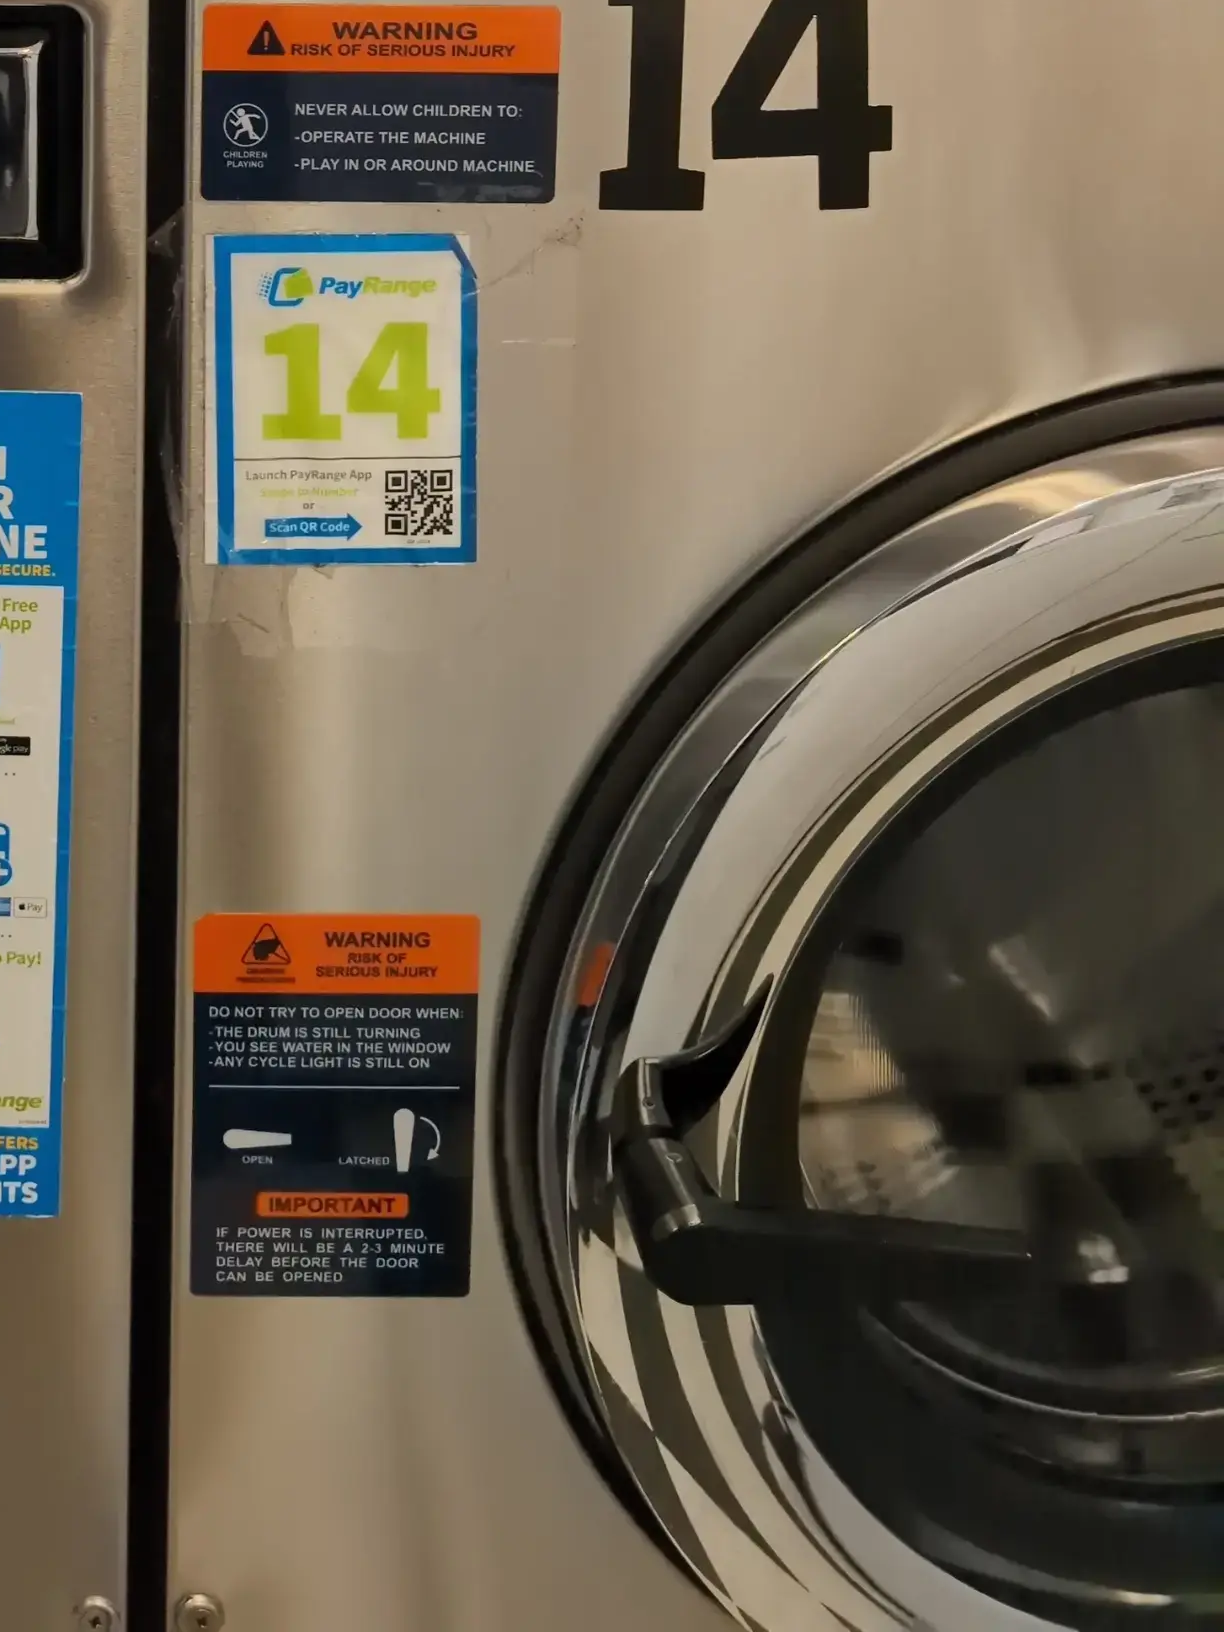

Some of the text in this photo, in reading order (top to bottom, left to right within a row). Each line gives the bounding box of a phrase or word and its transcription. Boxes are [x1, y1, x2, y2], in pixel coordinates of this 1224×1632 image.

[332, 21, 478, 41] WARNING
[291, 43, 516, 58] RISK OF SERIOUS INJURY
[295, 103, 523, 118] NEVER ALLOW CHILDREN TO:
[378, 131, 409, 144] THE
[414, 132, 486, 145] MACHINE
[344, 158, 359, 171] IN
[363, 159, 386, 172] OR
[390, 159, 459, 172] AROUND
[463, 160, 535, 173] MACHINE
[319, 277, 437, 299] PayRange
[262, 322, 441, 441] 14
[269, 521, 350, 533] Scan QR Code
[2, 598, 38, 613] Free
[324, 932, 431, 948] WARNING
[7, 951, 41, 968] Pay!
[347, 953, 407, 964] RISK OF
[316, 966, 438, 978] SERIOUS INJURY
[209, 1006, 230, 1018] DO
[234, 1006, 265, 1018] NOT
[269, 1006, 296, 1018] TRY
[300, 1006, 320, 1018] TO
[324, 1007, 364, 1018] OPEN
[369, 1007, 411, 1019] DOOR
[269, 1197, 397, 1213] IMPORTANT
[216, 1242, 445, 1254] THERE WILL BE A 2-3 MINUTE
[216, 1257, 419, 1269] DELAY BEFORE THE DOOR
